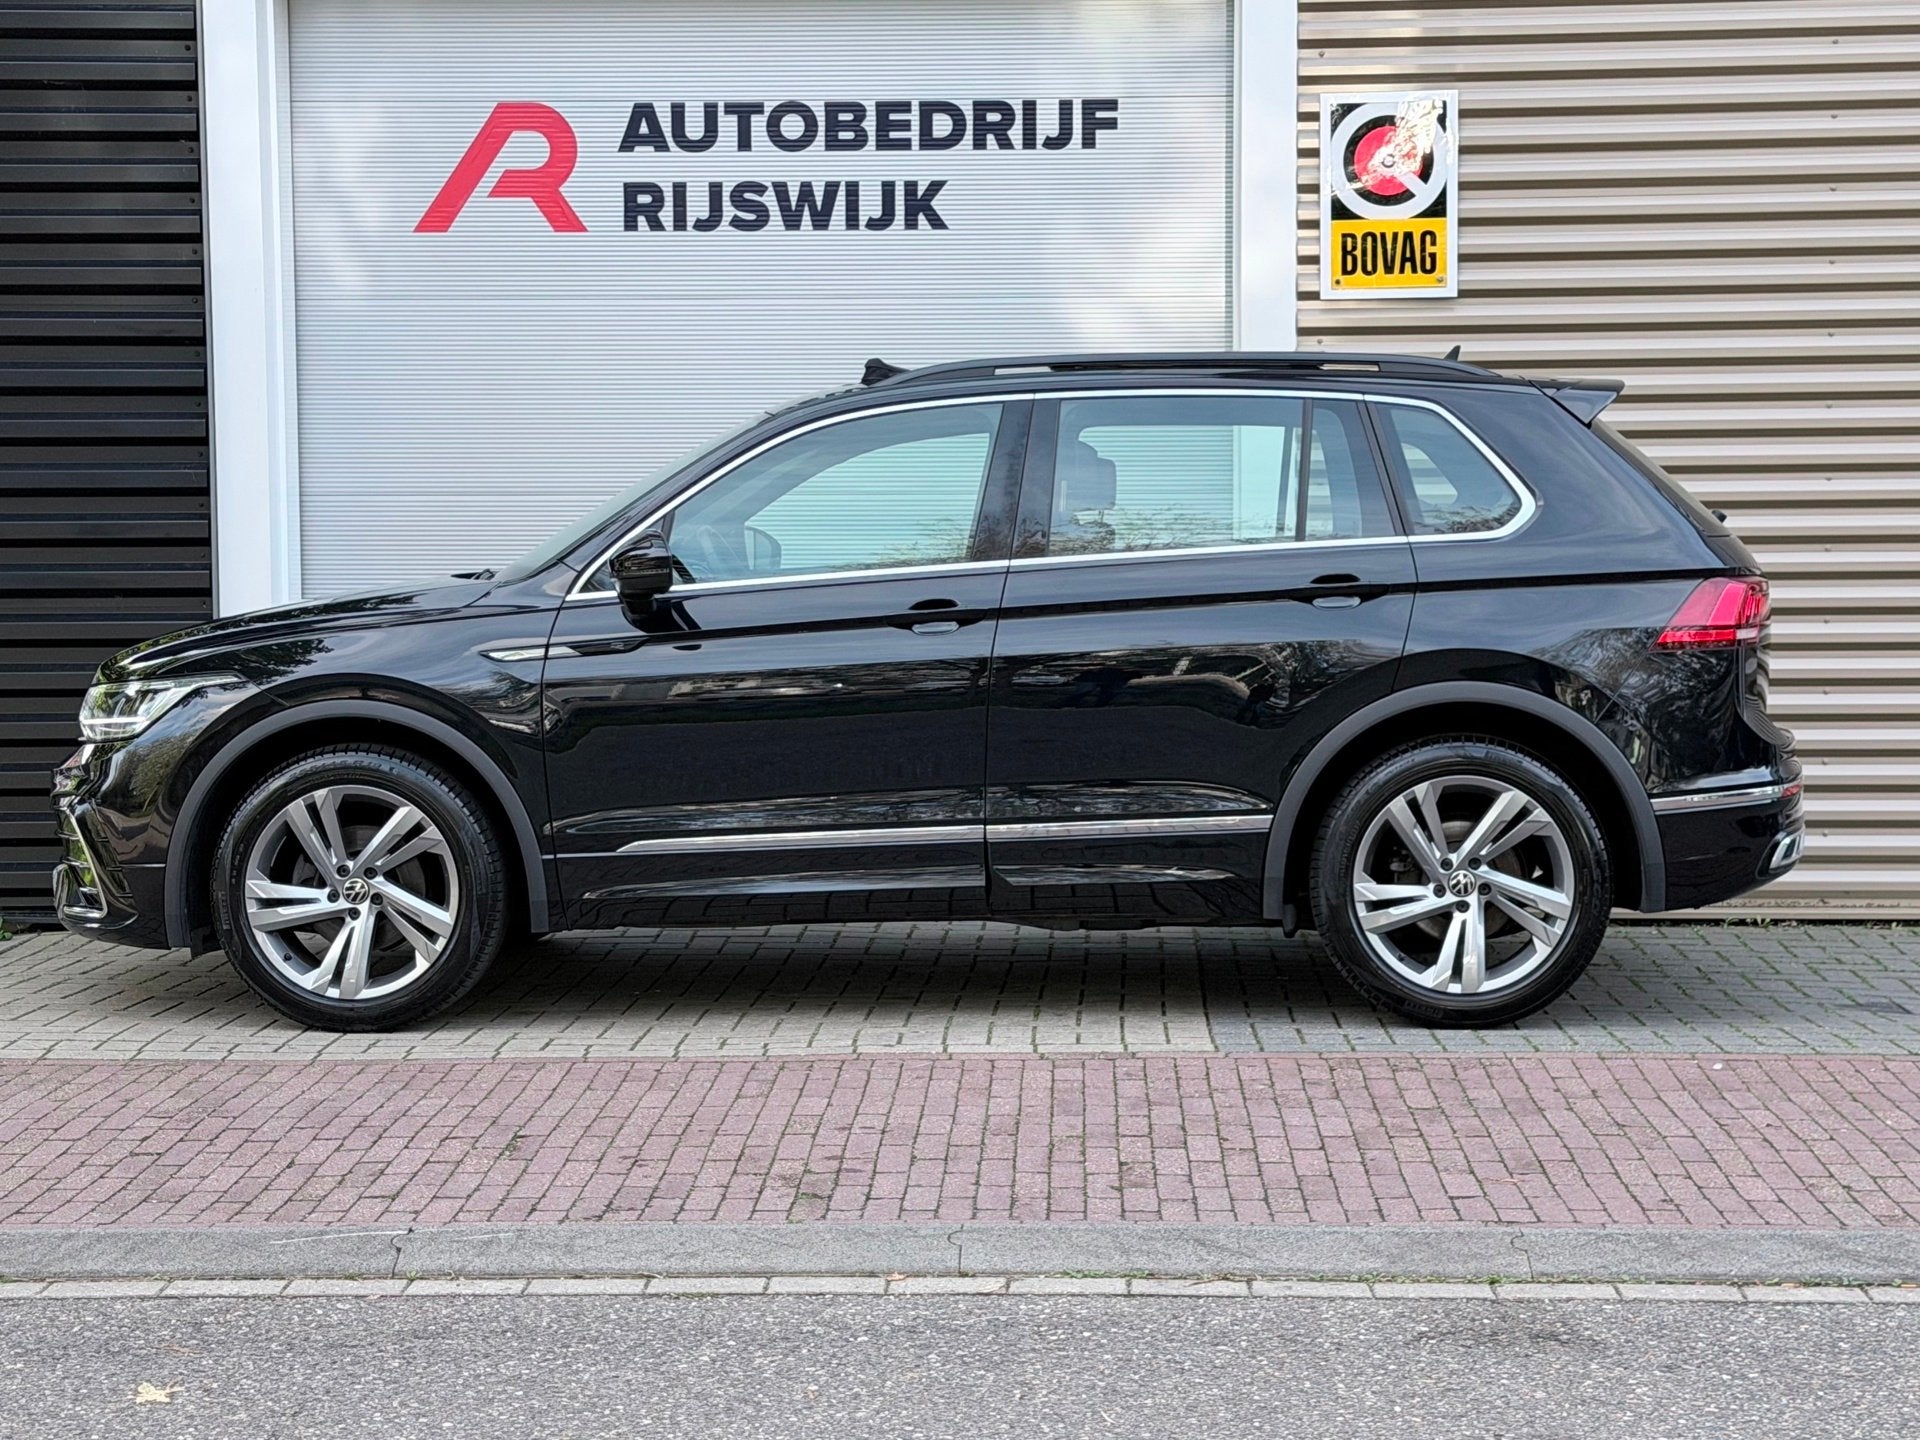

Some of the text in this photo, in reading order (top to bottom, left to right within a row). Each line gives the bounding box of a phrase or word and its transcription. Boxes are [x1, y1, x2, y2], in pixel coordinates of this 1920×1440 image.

[618, 98, 1120, 153] AUTOBEDRIJF
[623, 180, 949, 233] RIJSWIJK
[1341, 230, 1438, 276] BOVAG
